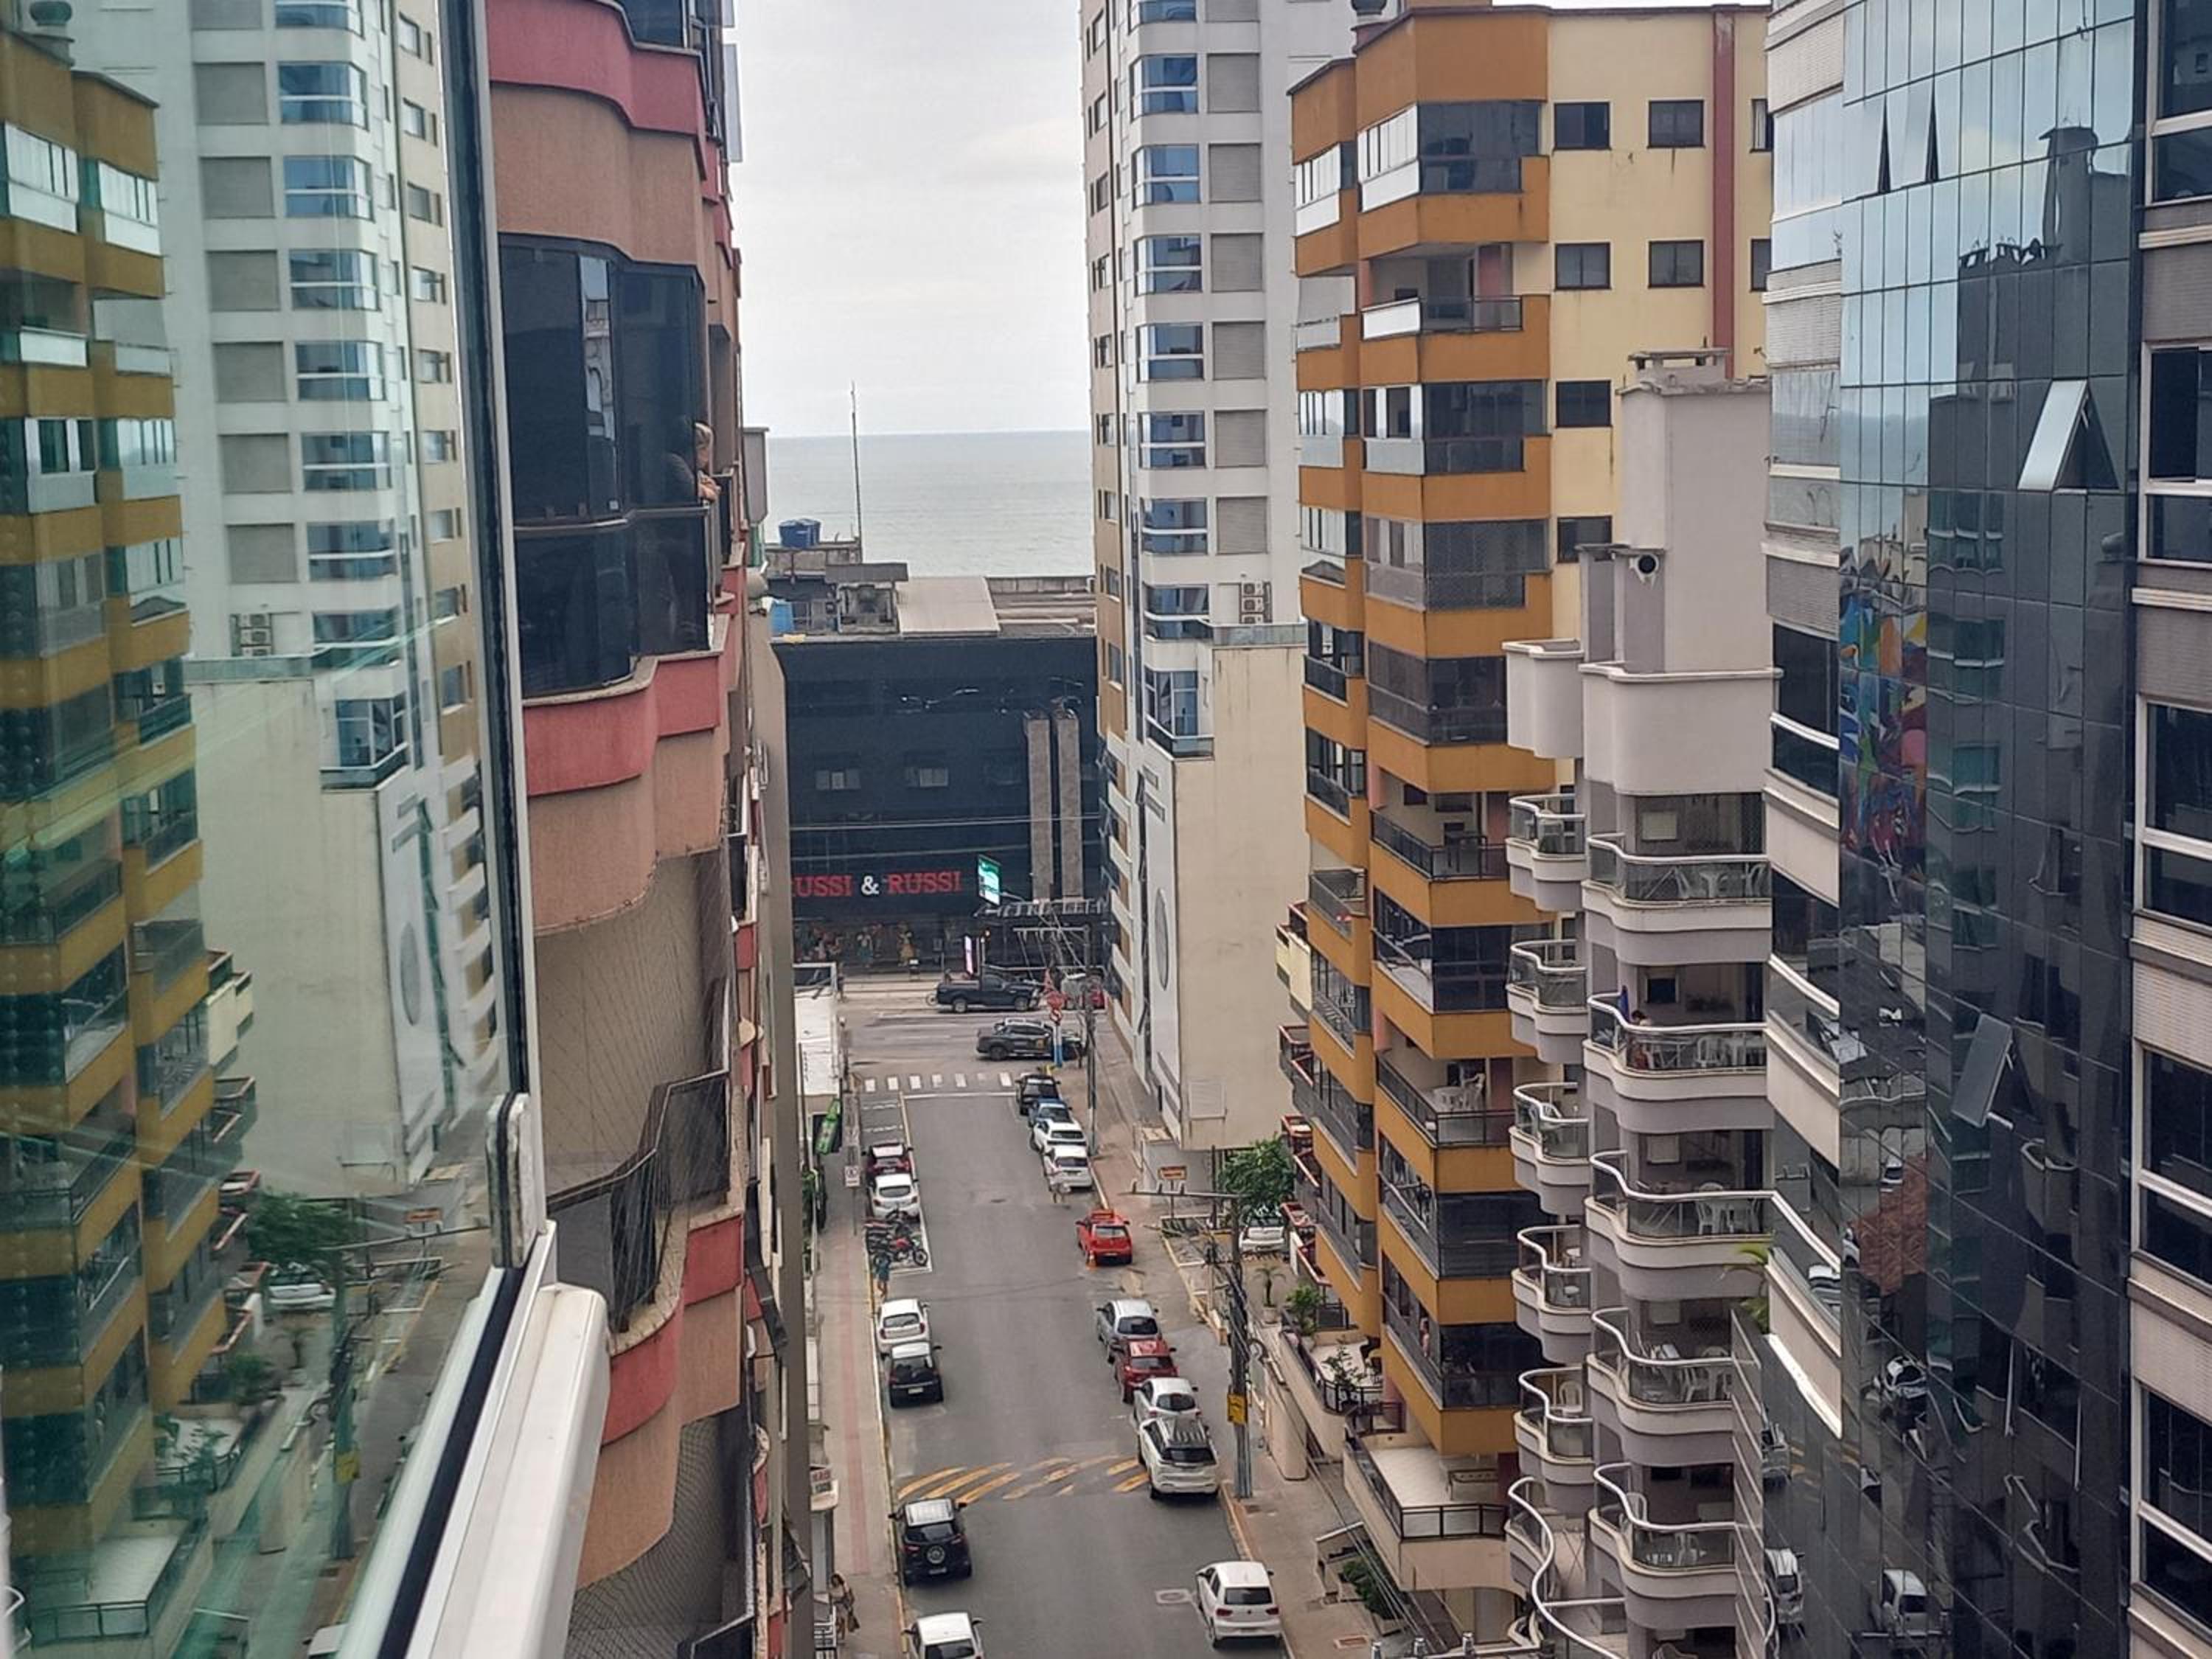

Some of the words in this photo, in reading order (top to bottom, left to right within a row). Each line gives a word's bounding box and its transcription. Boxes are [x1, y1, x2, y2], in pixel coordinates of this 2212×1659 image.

[792, 874, 852, 897] USSI
[860, 875, 880, 895] &
[887, 871, 961, 894] RUSSI
